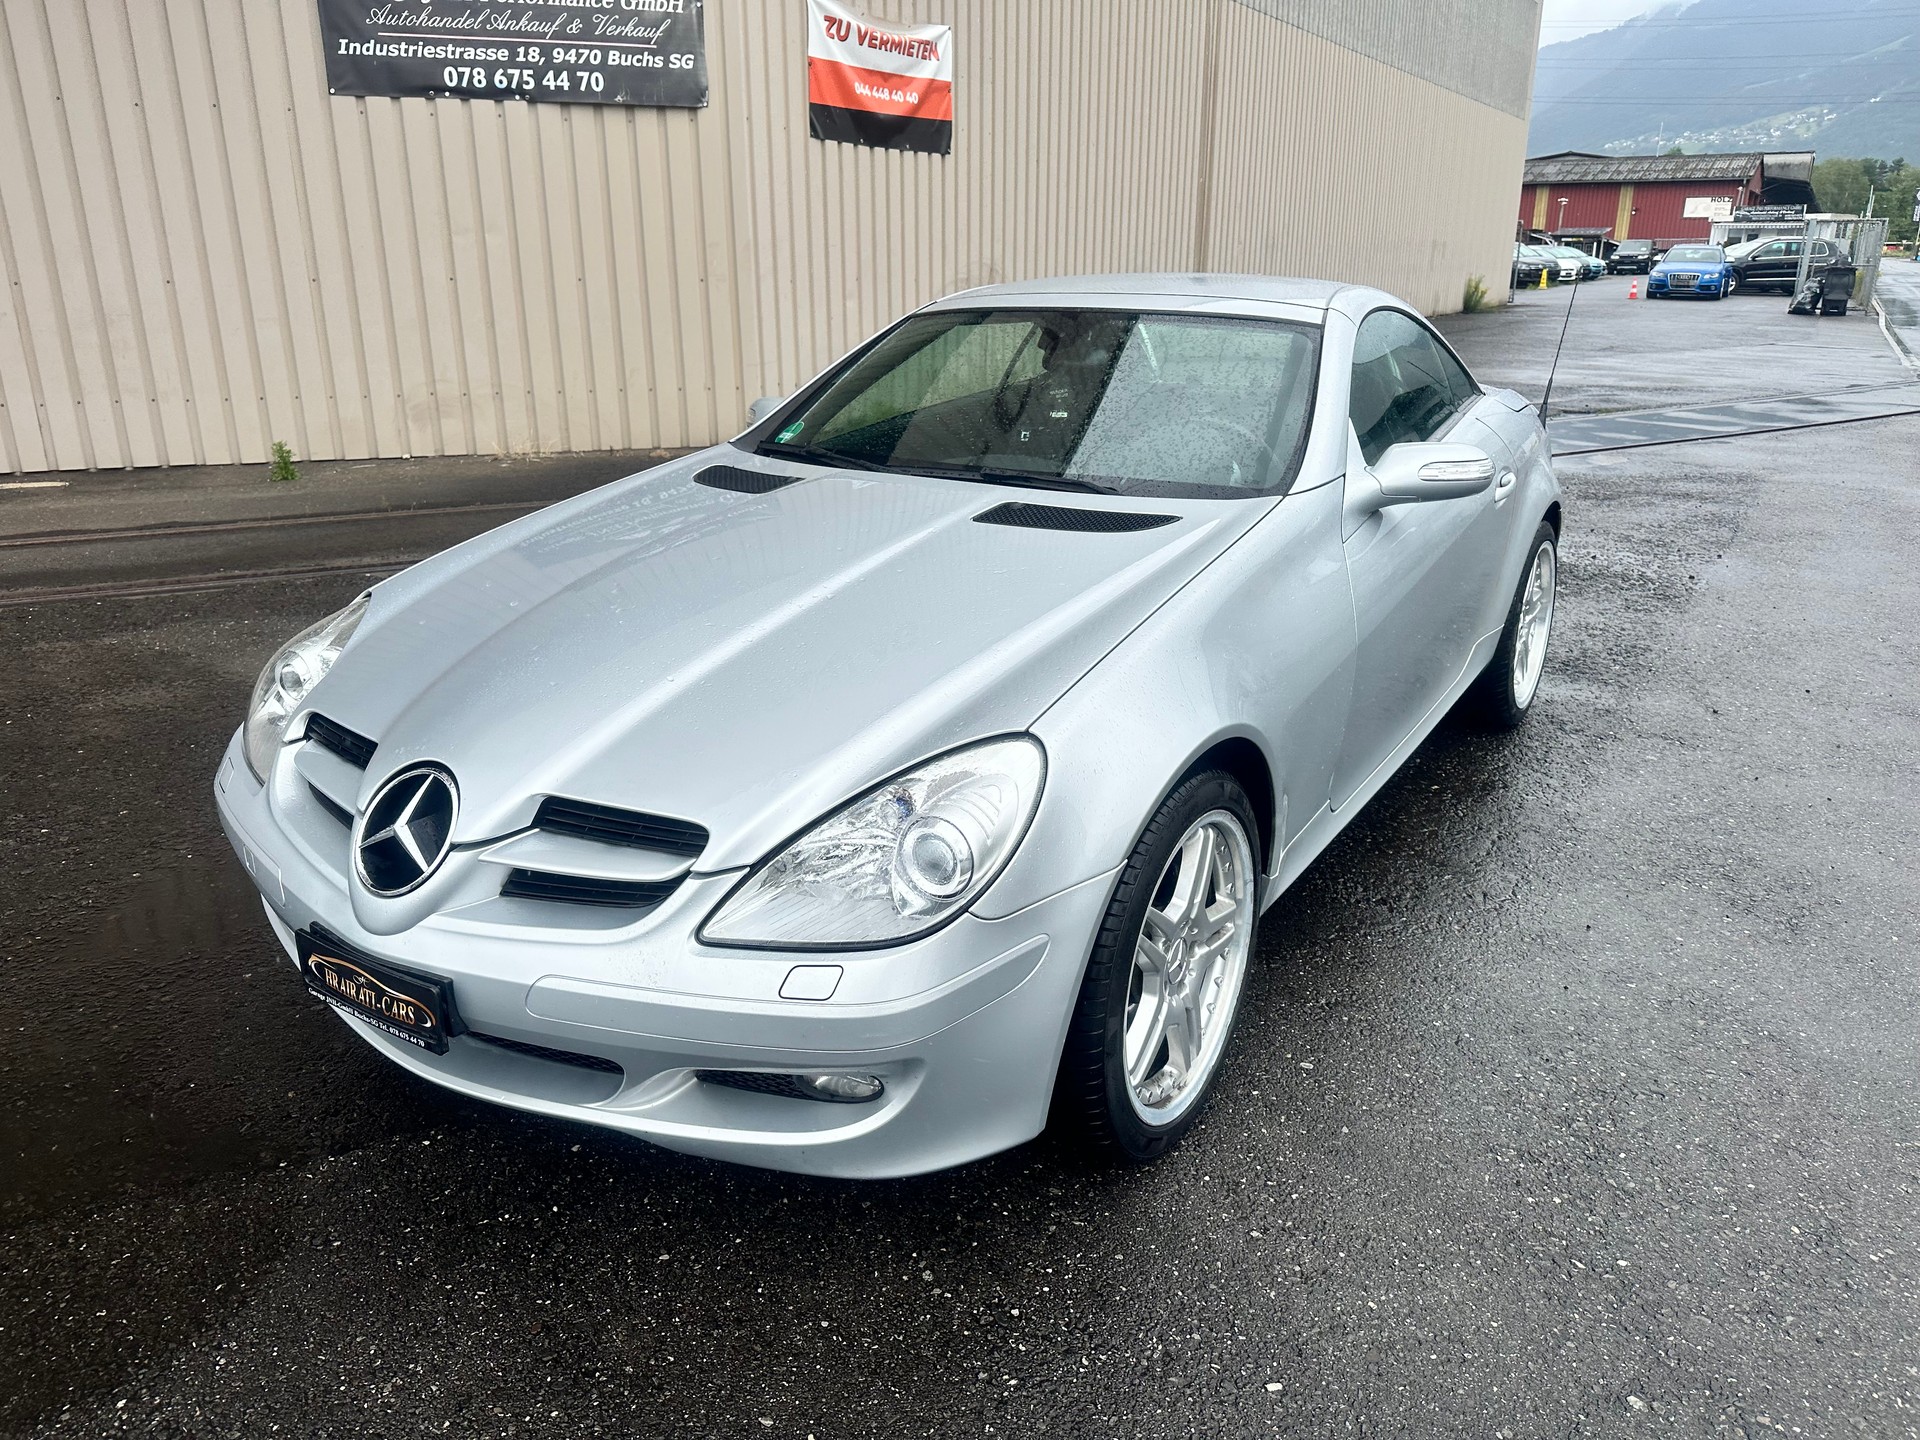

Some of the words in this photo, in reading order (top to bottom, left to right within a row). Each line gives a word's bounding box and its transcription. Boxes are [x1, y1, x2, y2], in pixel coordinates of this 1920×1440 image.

[621, 0, 685, 13] GmbH
[366, 4, 490, 30] Autohandel
[486, 9, 567, 39] Ankauf
[566, 18, 583, 34] &
[592, 14, 671, 44] Verkauf
[824, 15, 851, 42] ZU
[856, 24, 940, 61] VERMIETEN
[338, 39, 509, 62] Industriestrasse
[515, 46, 545, 65] 18,
[552, 48, 601, 65] 9470
[607, 50, 663, 68] Buchs
[669, 54, 695, 69] SG
[443, 66, 487, 88] 078
[494, 68, 535, 90] 675
[542, 70, 570, 90] 44
[576, 71, 604, 92] 70
[854, 82, 871, 97] 044
[872, 86, 890, 100] 448
[891, 89, 903, 102] 40
[906, 92, 918, 104] 40
[389, 1026, 399, 1036] 078
[400, 1031, 409, 1040] 675
[410, 1036, 417, 1044] 44
[417, 1039, 425, 1047] 70
